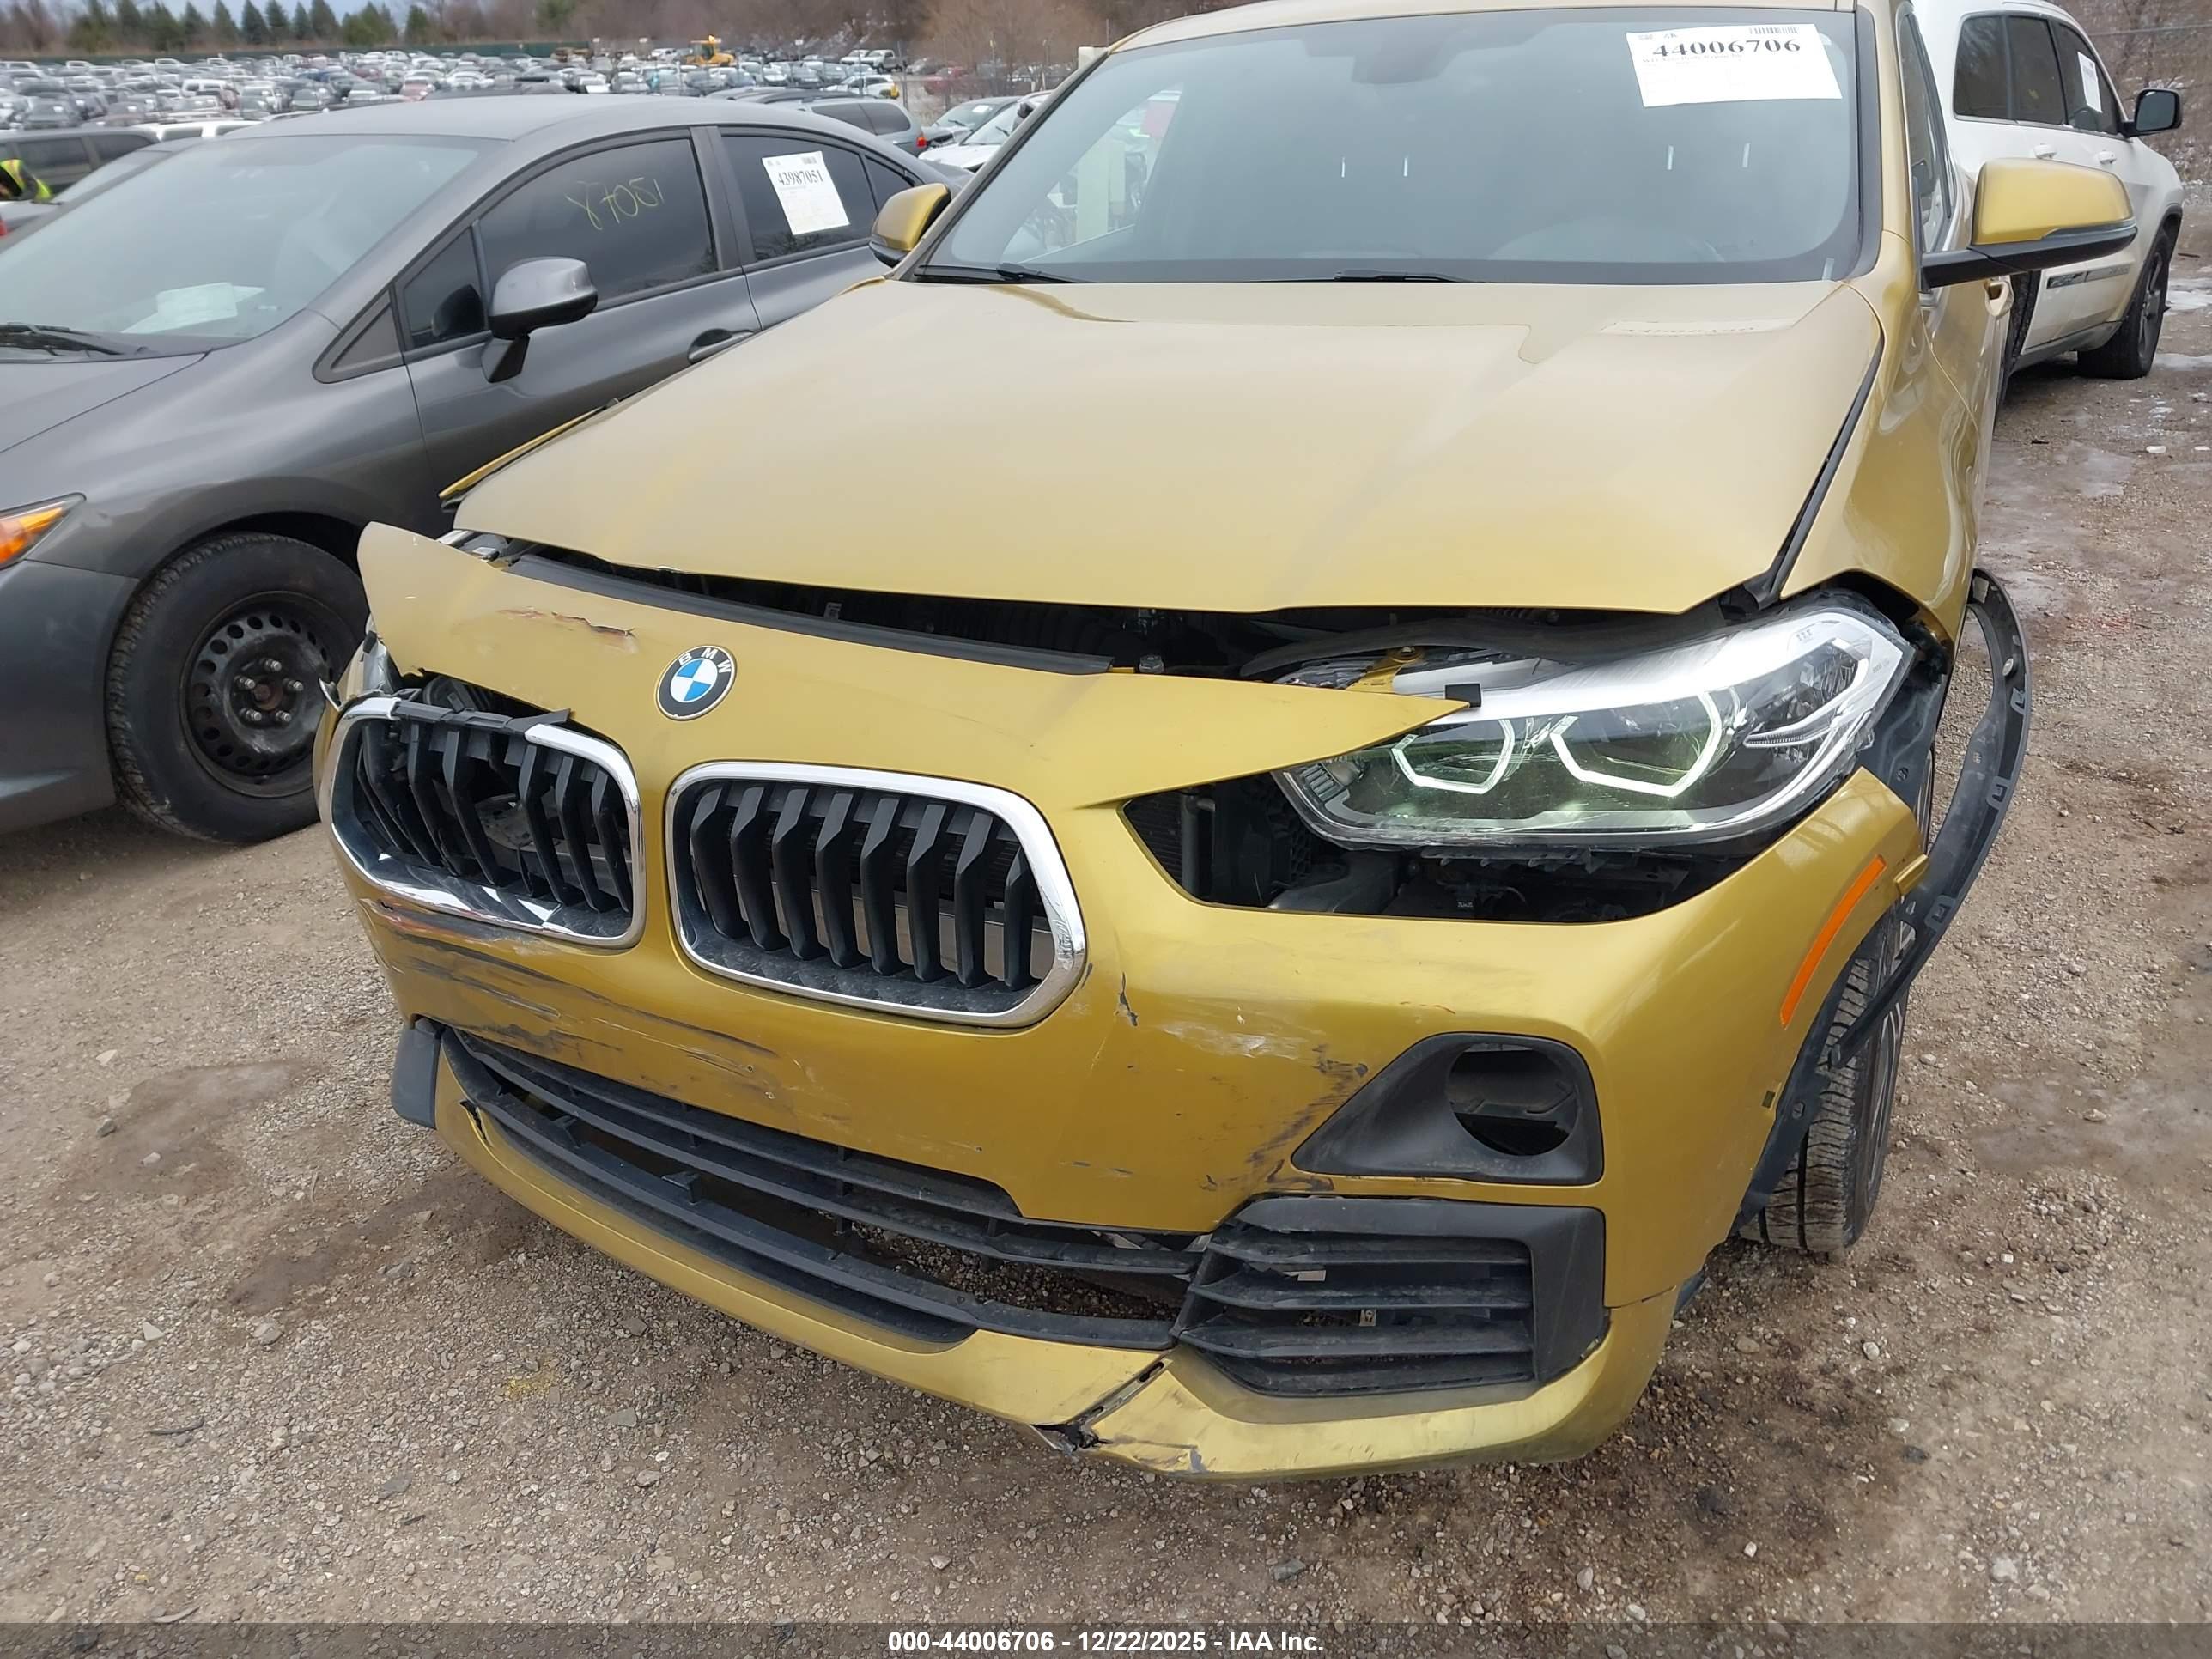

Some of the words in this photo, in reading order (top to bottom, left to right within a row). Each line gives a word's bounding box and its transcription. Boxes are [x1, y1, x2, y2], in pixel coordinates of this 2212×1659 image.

[1652, 39, 1801, 57] 44006706
[777, 169, 825, 186] 43987051
[678, 647, 732, 674] BMW
